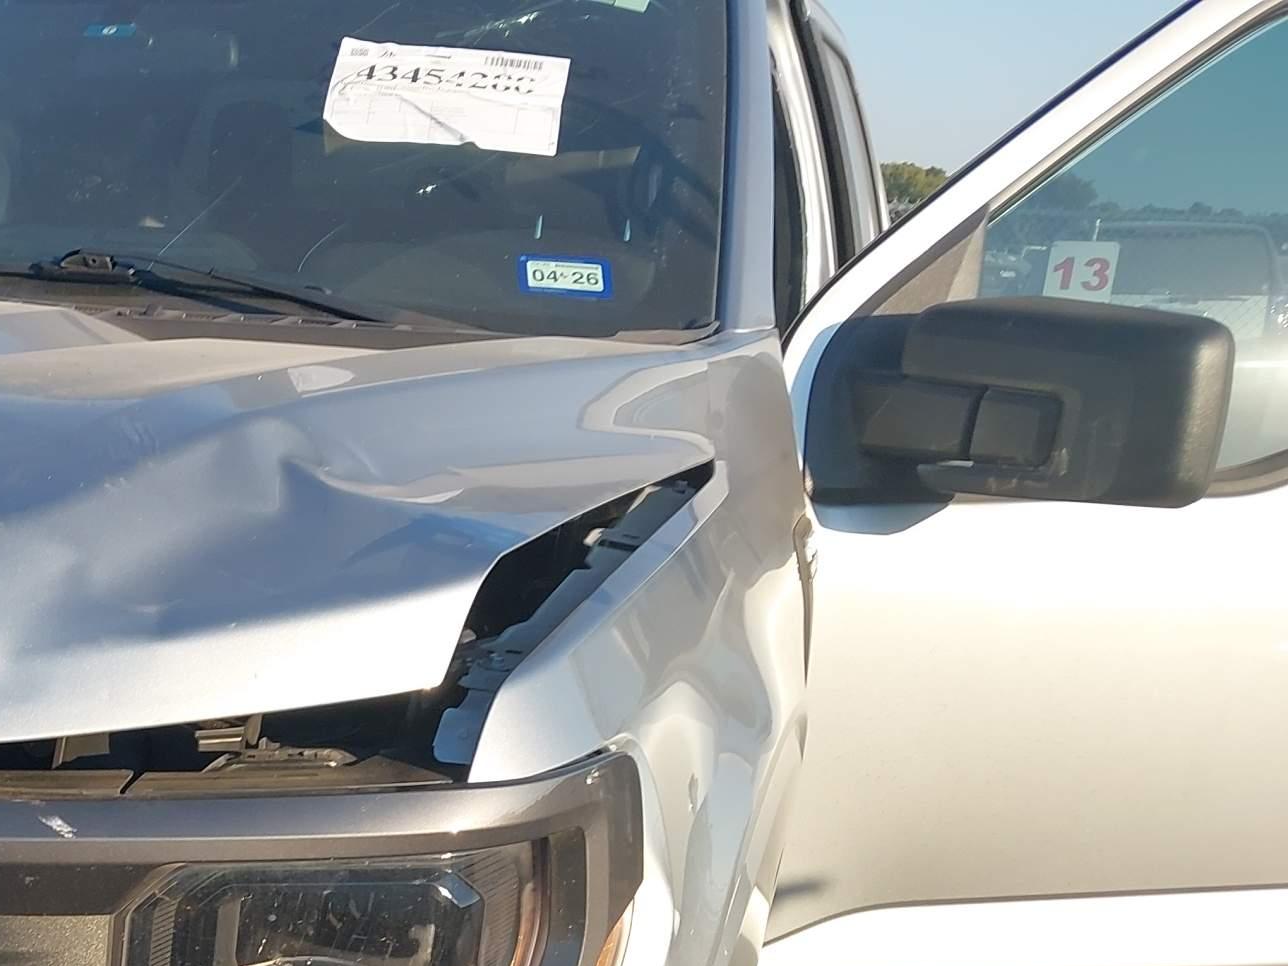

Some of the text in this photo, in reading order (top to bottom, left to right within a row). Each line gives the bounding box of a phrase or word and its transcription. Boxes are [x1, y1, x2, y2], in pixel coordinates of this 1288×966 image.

[532, 268, 600, 286] 04 26
[1053, 256, 1111, 292] 13
